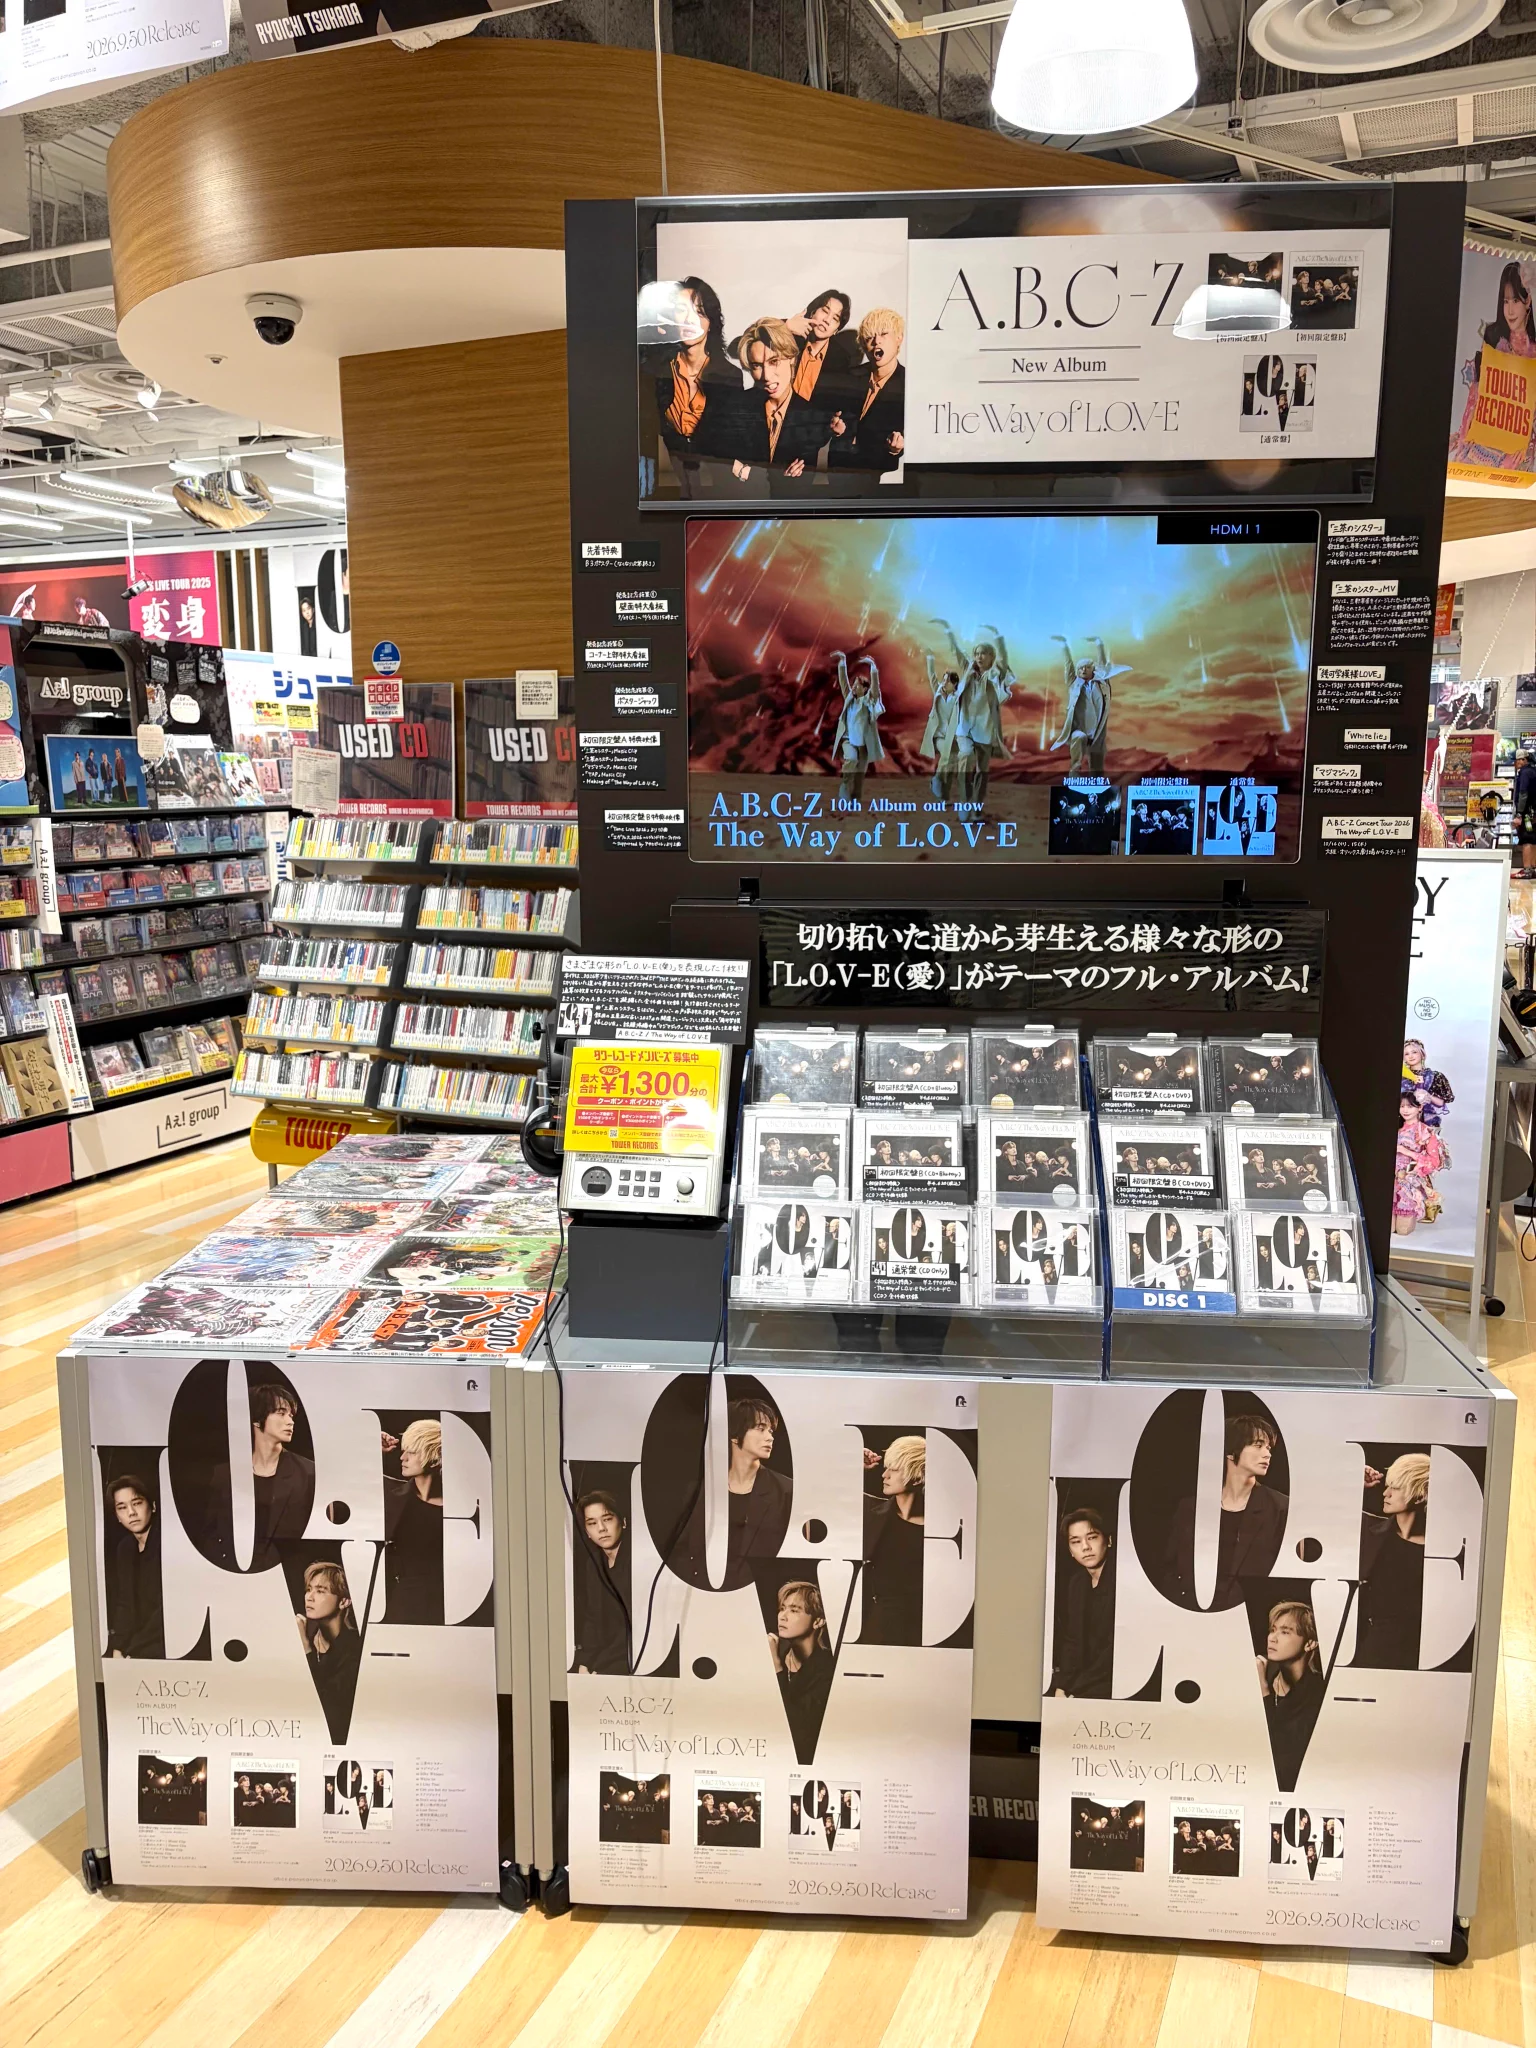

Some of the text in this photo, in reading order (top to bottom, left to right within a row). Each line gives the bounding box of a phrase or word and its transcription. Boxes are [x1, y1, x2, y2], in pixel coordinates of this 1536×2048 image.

[255, 2, 363, 45] RYOICHI TSUKADA
[930, 259, 1184, 331] A.B.C-Z
[1012, 356, 1107, 373] New Album
[1486, 366, 1528, 405] TOWER
[928, 399, 1180, 444] The Way of L.O.V-E
[1475, 394, 1531, 437] RECORDS
[1210, 523, 1261, 536] HDMI 1
[587, 545, 619, 556] 先着特典
[154, 579, 170, 592] LIVE
[170, 578, 190, 590] TOUR
[191, 577, 211, 589] 2025
[619, 602, 665, 611] 壁面特大看板
[141, 595, 207, 640] 変身
[589, 651, 647, 660] コーナー上部特大看板
[73, 684, 123, 707] group
[617, 697, 657, 705] ポスタージャック
[338, 723, 429, 759] USED CD
[488, 727, 549, 762] USED
[359, 803, 388, 815] RECORDS
[486, 805, 541, 816] TOWER RECORDS
[709, 792, 985, 818] A.B.C-Z 10th Album out now
[708, 821, 765, 848] The
[777, 822, 842, 855] Way
[854, 821, 886, 848] of
[897, 822, 1019, 848] L.O.V-E
[1335, 828, 1348, 836] The
[1348, 829, 1363, 837] Way
[1363, 828, 1371, 836] of
[40, 872, 51, 905] group
[796, 922, 1283, 953] 切り拓いた道から芽生える様々な形の
[664, 1032, 678, 1041] Way
[580, 1074, 599, 1083] 最大
[601, 1066, 620, 1074] 今なら
[579, 1071, 708, 1096] 合計 ¥1,300 分の
[189, 1105, 220, 1127] group
[611, 1140, 659, 1150] TOWER RECORDS
[1143, 1292, 1206, 1309] DISC 1
[488, 1293, 541, 1351] person
[136, 1679, 209, 1699] A.B.C-Z
[599, 1695, 675, 1716] A.B.C-Z
[137, 1716, 301, 1743] The Way of L.O.V-E
[1072, 1720, 1152, 1741] A.B.C-Z
[599, 1731, 767, 1760] The Way of L.O.V-E
[1072, 1756, 1247, 1788] The Way of L.O.V-E
[405, 1859, 469, 1876] Release
[870, 1883, 937, 1901] Release
[1351, 1913, 1421, 1932] Release
